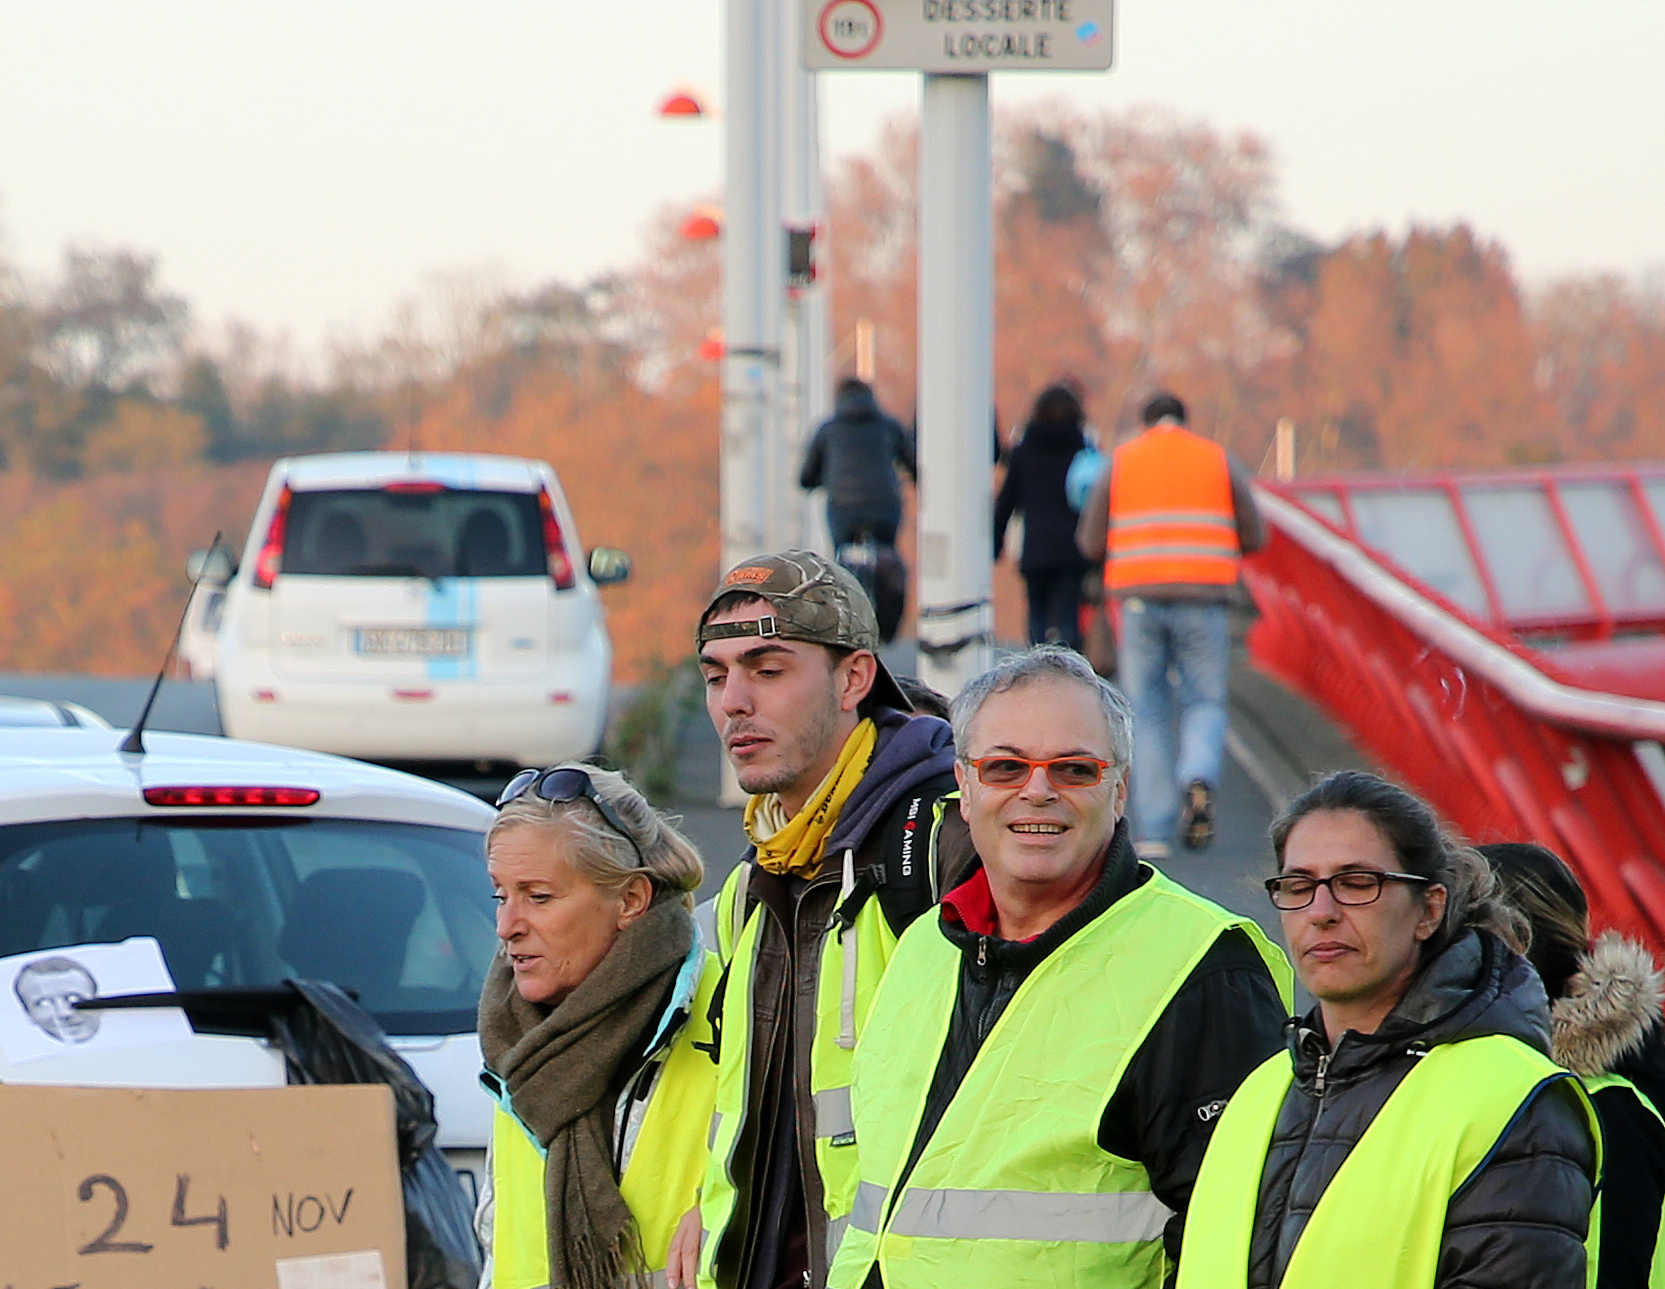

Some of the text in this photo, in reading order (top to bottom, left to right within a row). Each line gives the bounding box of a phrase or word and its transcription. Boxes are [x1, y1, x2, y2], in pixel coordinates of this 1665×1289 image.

[943, 33, 1054, 60] LOCALE
[77, 1174, 231, 1256] 24
[272, 1188, 354, 1238] NOV
